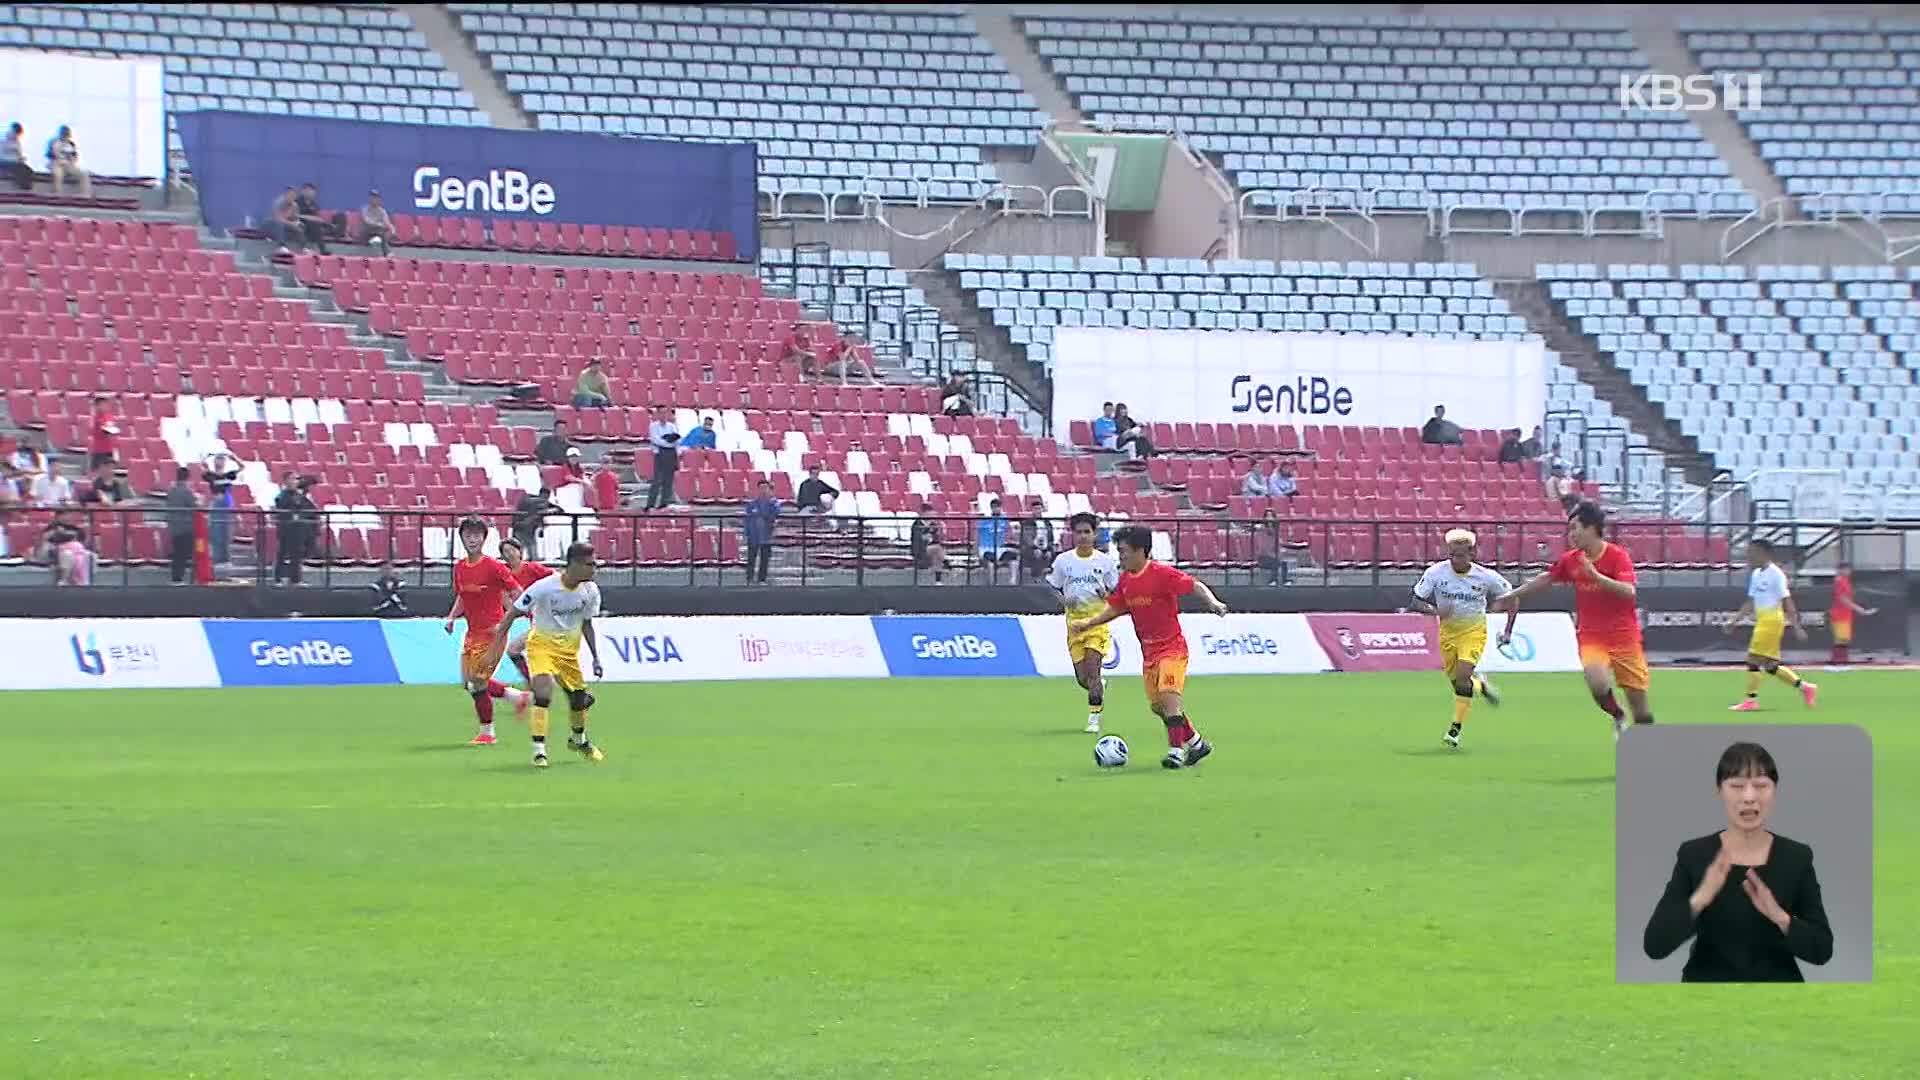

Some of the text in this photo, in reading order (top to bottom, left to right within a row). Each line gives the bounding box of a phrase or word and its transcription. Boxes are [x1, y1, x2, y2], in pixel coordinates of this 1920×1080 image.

[414, 166, 556, 214] SentBe
[1231, 375, 1353, 415] SentBe
[249, 639, 353, 667] SentBe
[605, 635, 683, 663] VISA
[911, 634, 998, 660] SentBe
[1201, 634, 1278, 656] SentBe
